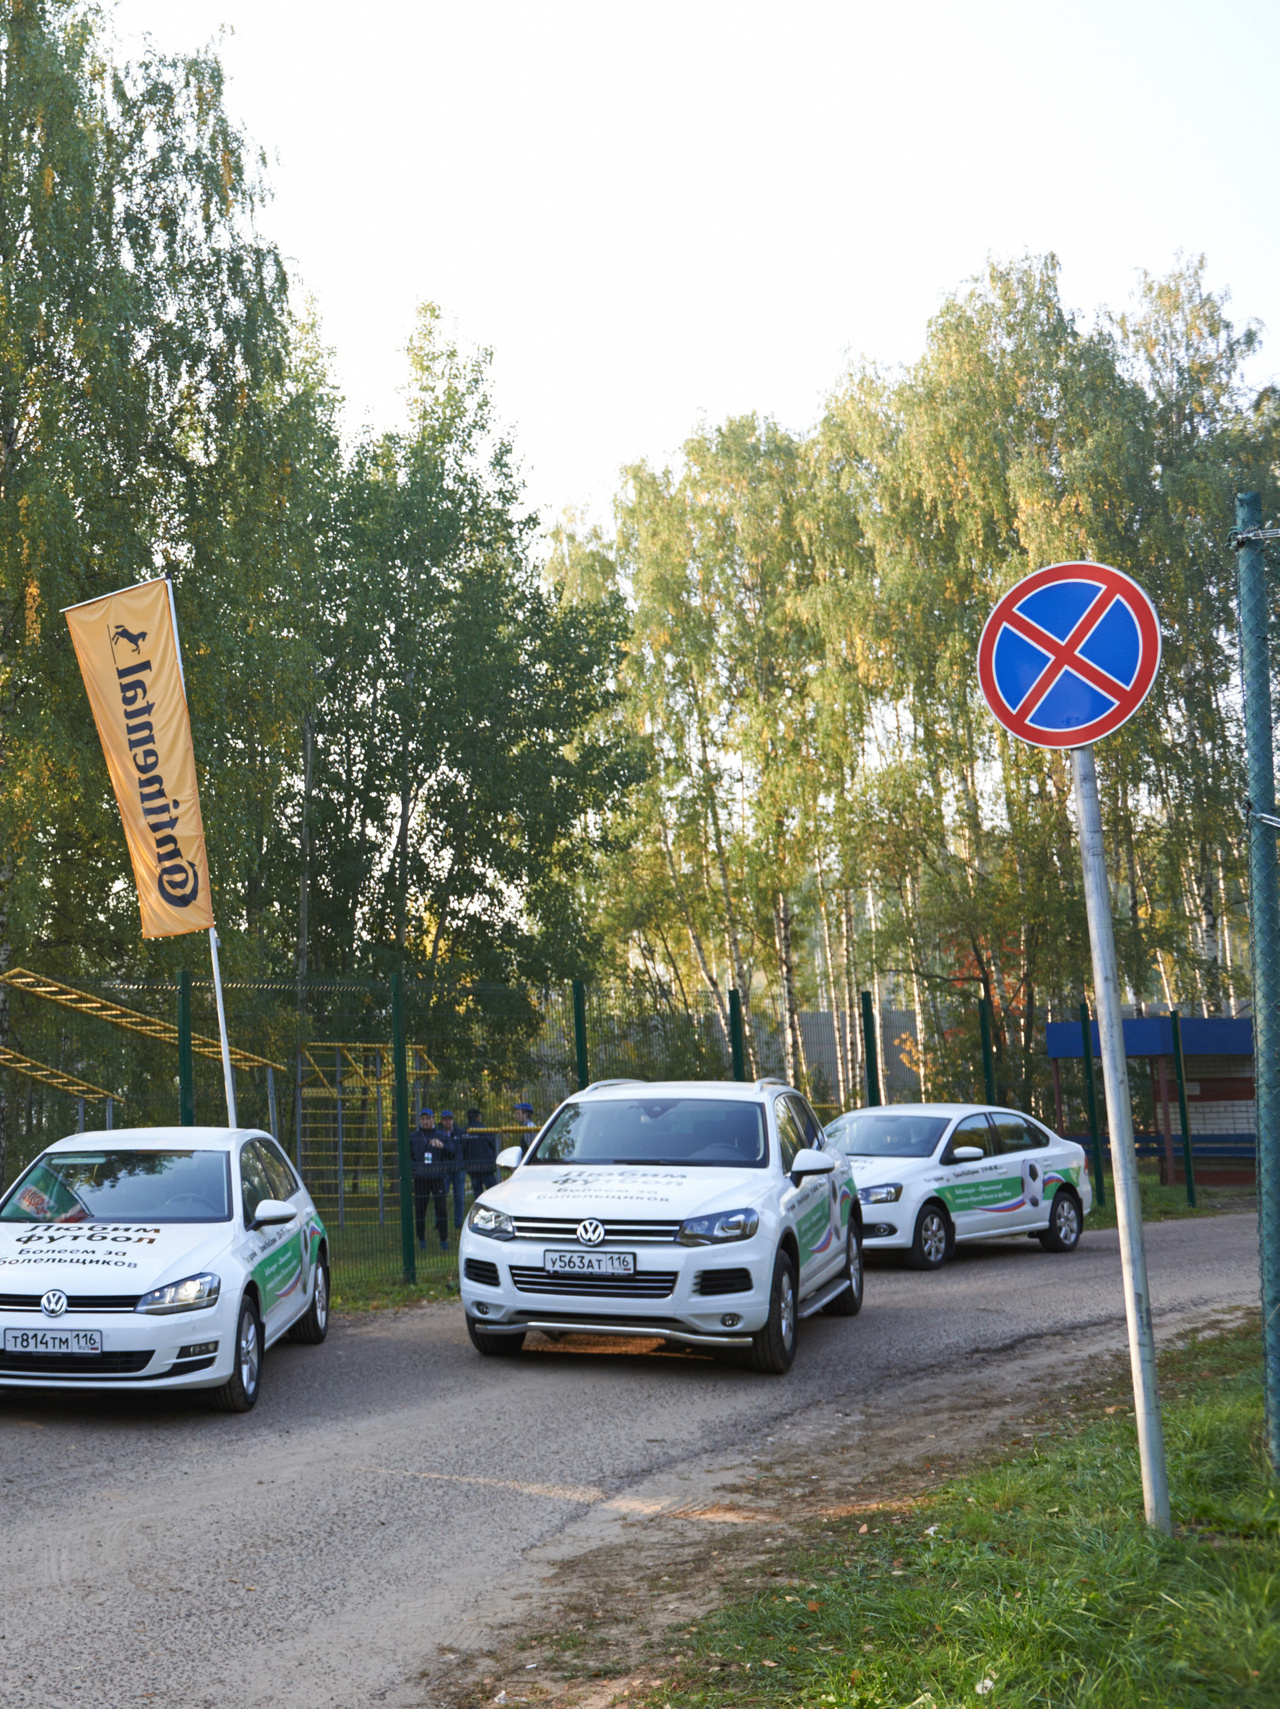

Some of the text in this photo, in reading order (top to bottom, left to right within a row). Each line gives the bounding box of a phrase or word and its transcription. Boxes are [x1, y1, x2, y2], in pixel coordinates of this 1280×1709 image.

[24, 1224, 161, 1234] Любим
[15, 1232, 157, 1244] футбол
[608, 1255, 629, 1267] 116
[74, 1333, 96, 1346] 116
